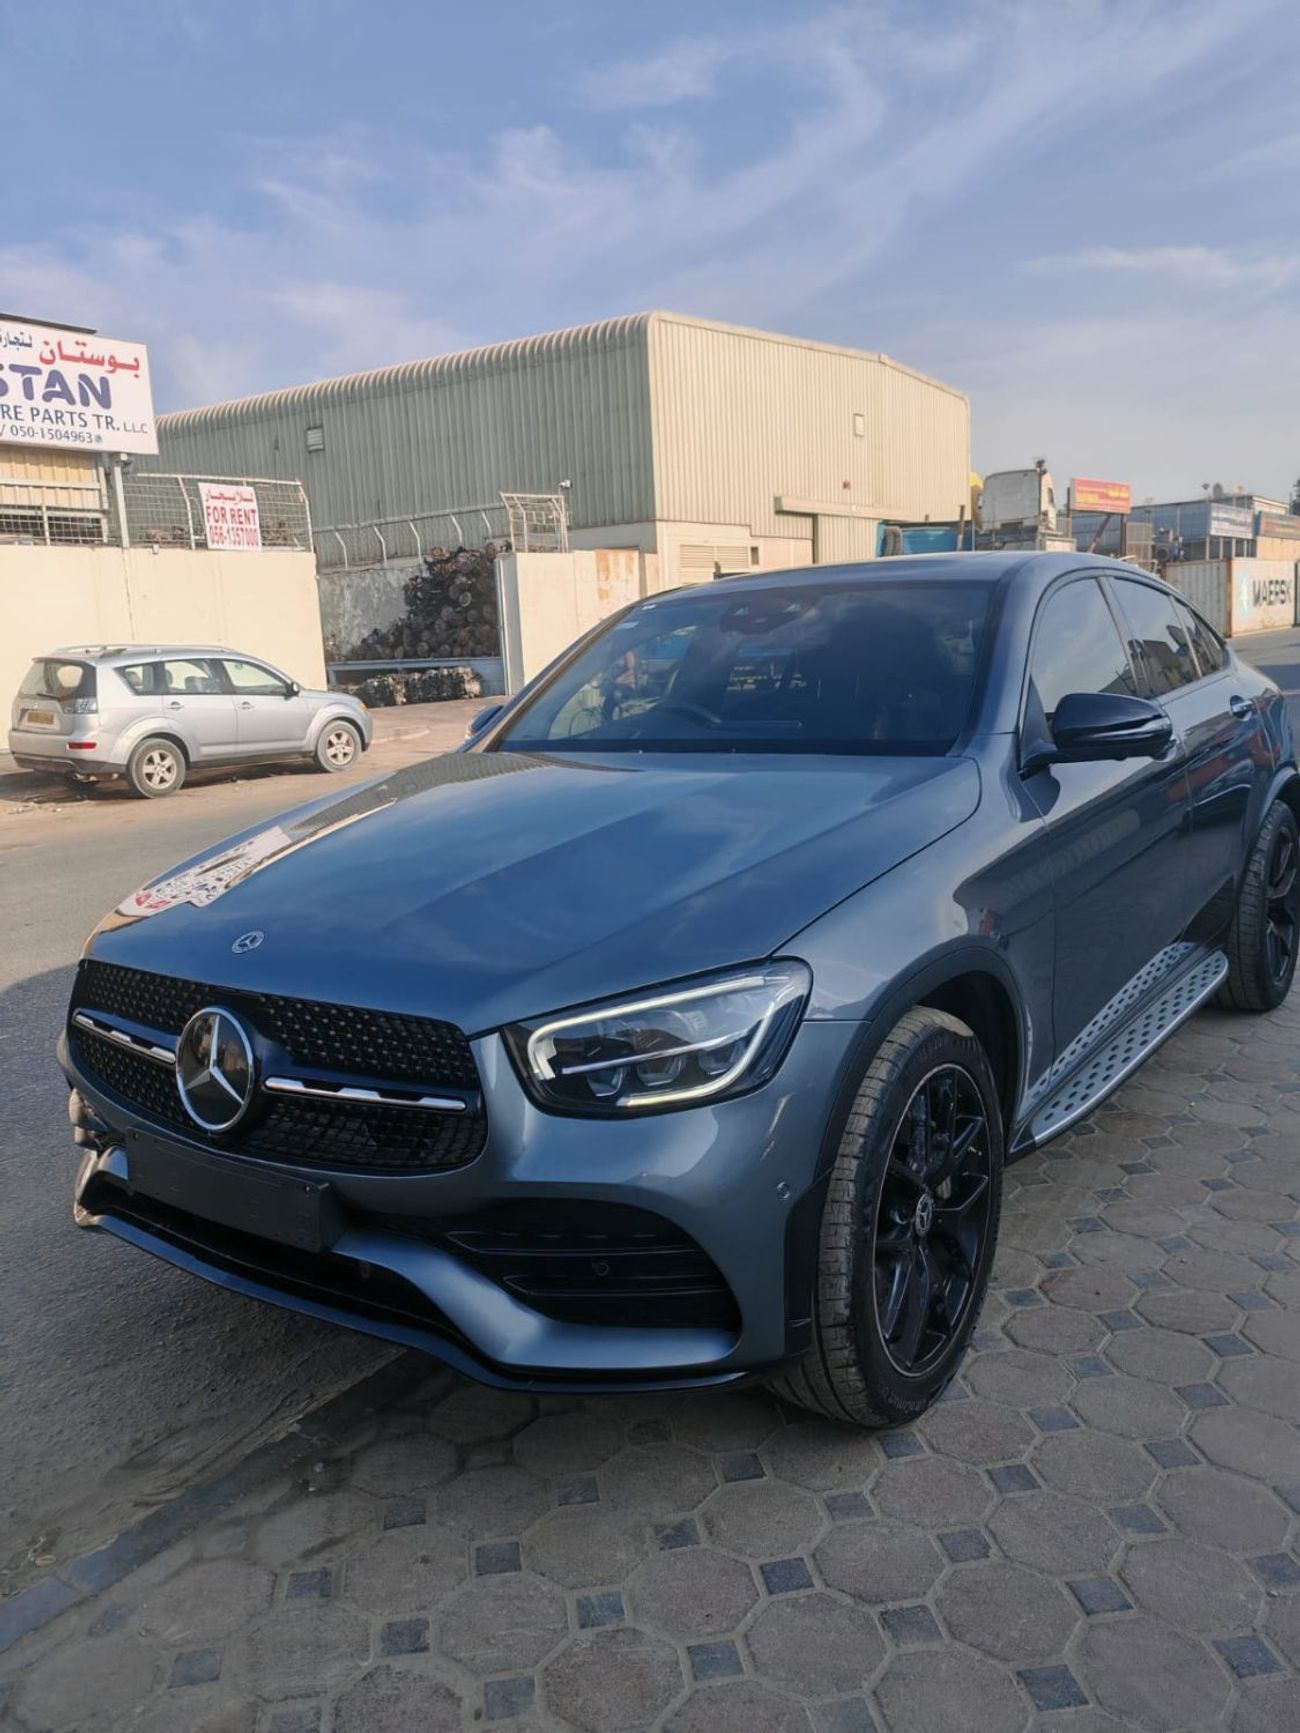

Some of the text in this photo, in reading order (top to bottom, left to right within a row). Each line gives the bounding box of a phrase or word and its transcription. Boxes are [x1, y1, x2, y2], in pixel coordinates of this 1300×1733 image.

[0, 363, 112, 410] TAN
[30, 407, 87, 428] PARTS
[92, 413, 120, 431] TR.
[206, 505, 256, 526] FOR RENT
